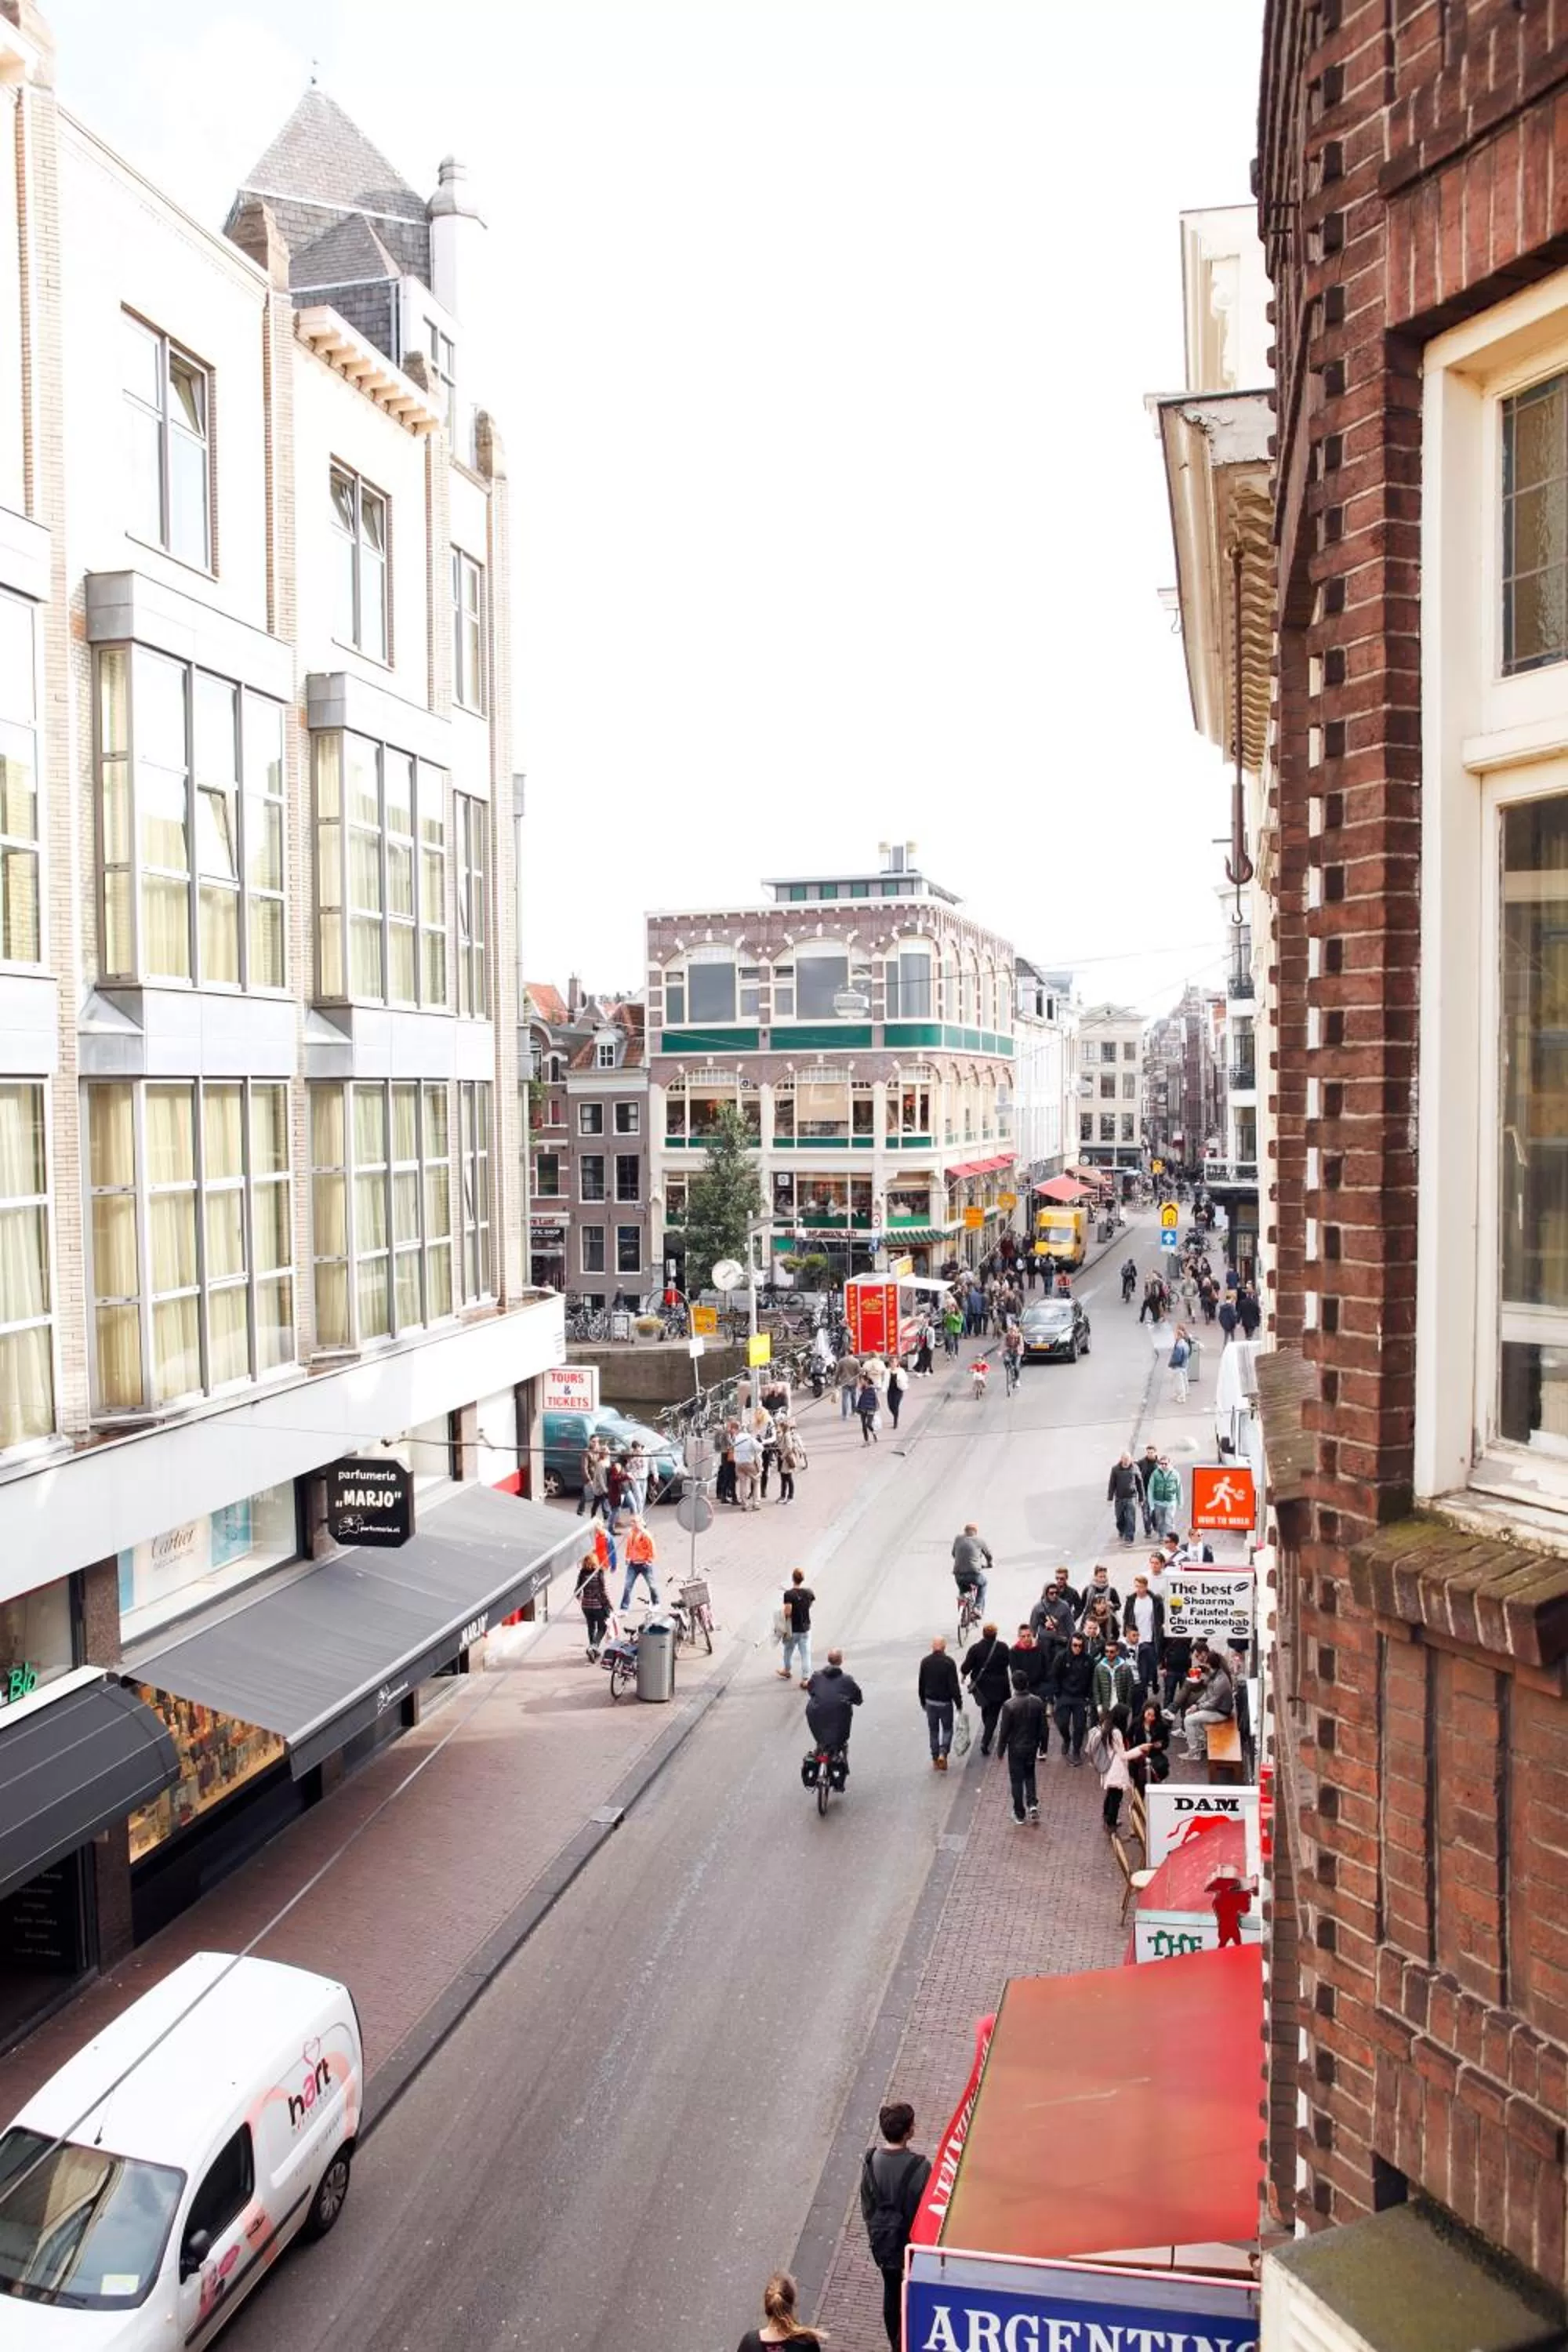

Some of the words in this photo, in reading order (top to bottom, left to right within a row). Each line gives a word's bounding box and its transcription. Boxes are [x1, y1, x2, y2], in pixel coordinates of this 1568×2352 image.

[551, 1373, 584, 1384] TOURS
[564, 1385, 572, 1395] &
[546, 1396, 589, 1407] TICKETS
[338, 1469, 397, 1481] parfumerie
[1170, 1582, 1197, 1595] The
[1201, 1583, 1232, 1595] best
[1183, 1595, 1235, 1606] Shoarma
[1189, 1607, 1229, 1616] Falafel
[1169, 1616, 1250, 1627] Chickenkebab
[1174, 1797, 1240, 1812] DAM
[921, 2306, 1261, 2352] ARGENT
